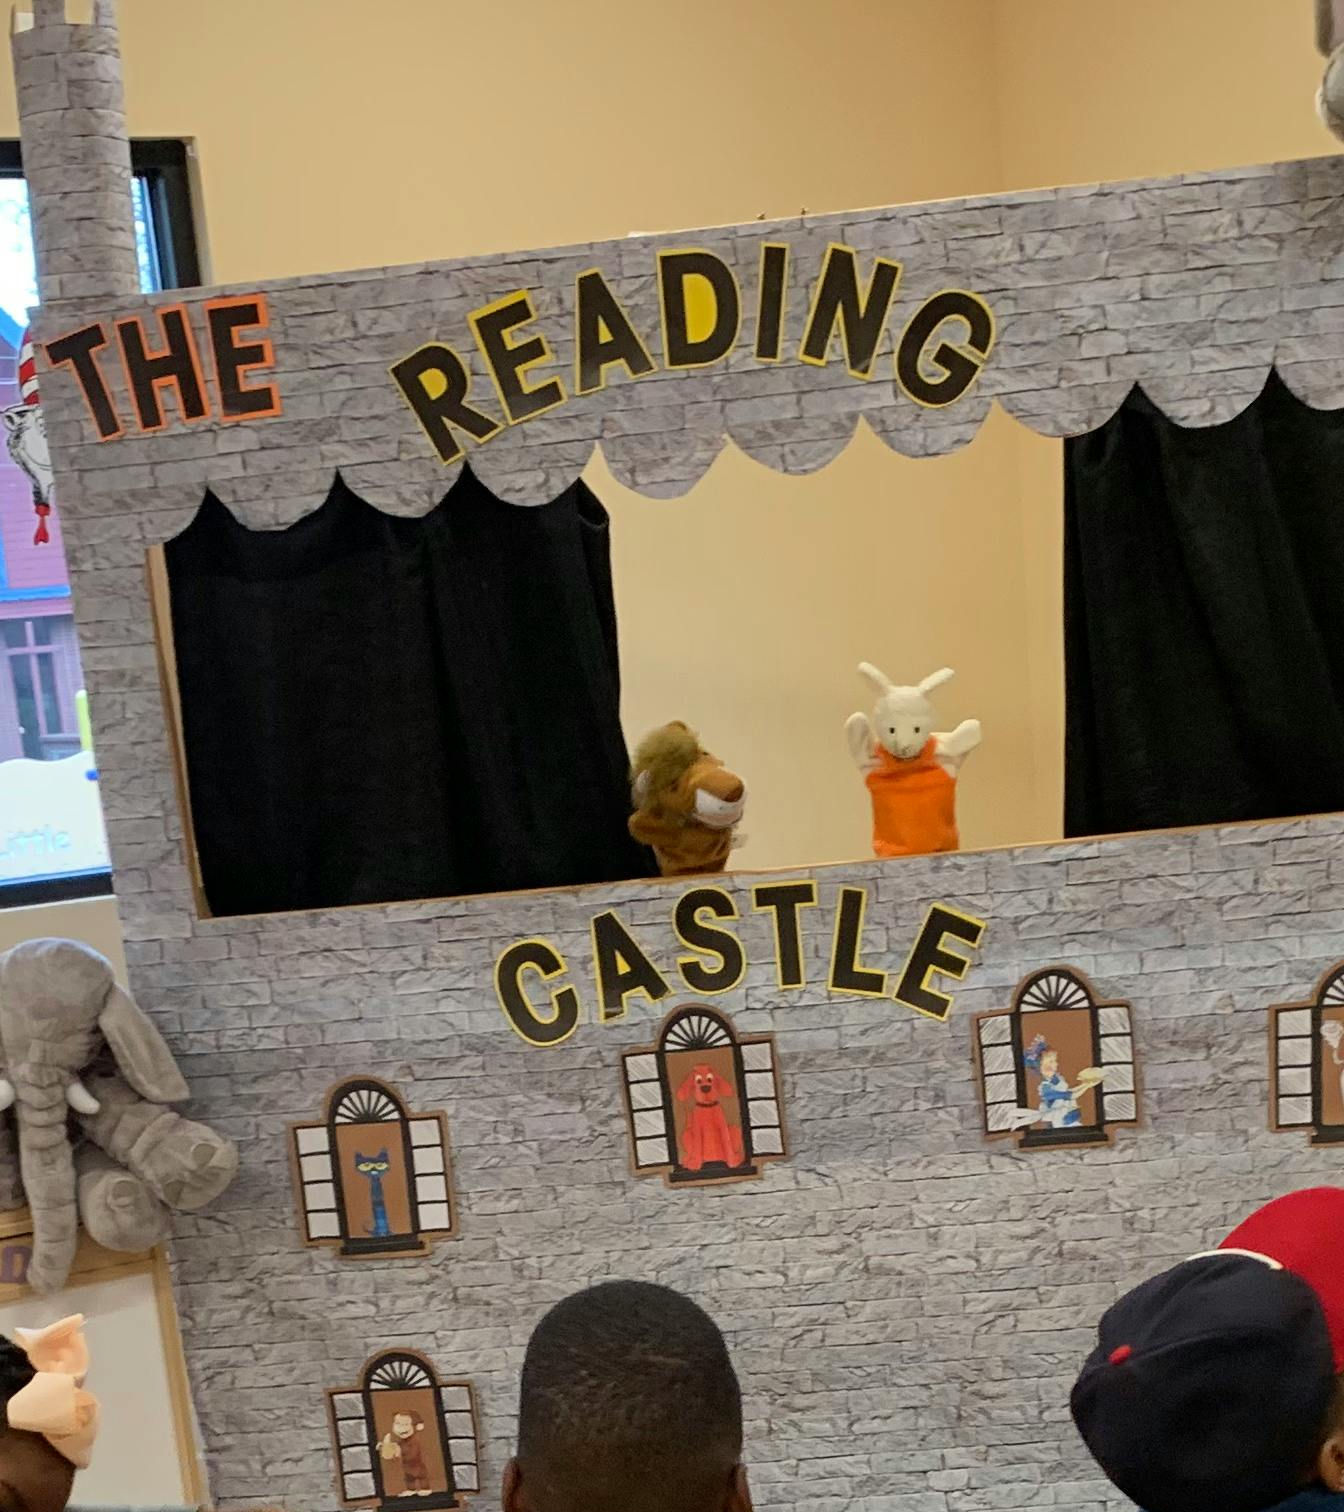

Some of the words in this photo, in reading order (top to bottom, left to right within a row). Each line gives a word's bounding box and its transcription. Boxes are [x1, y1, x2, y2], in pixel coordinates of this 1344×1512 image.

[40, 293, 281, 442] THE
[388, 242, 995, 465] READING
[495, 879, 988, 1047] CASTLE
